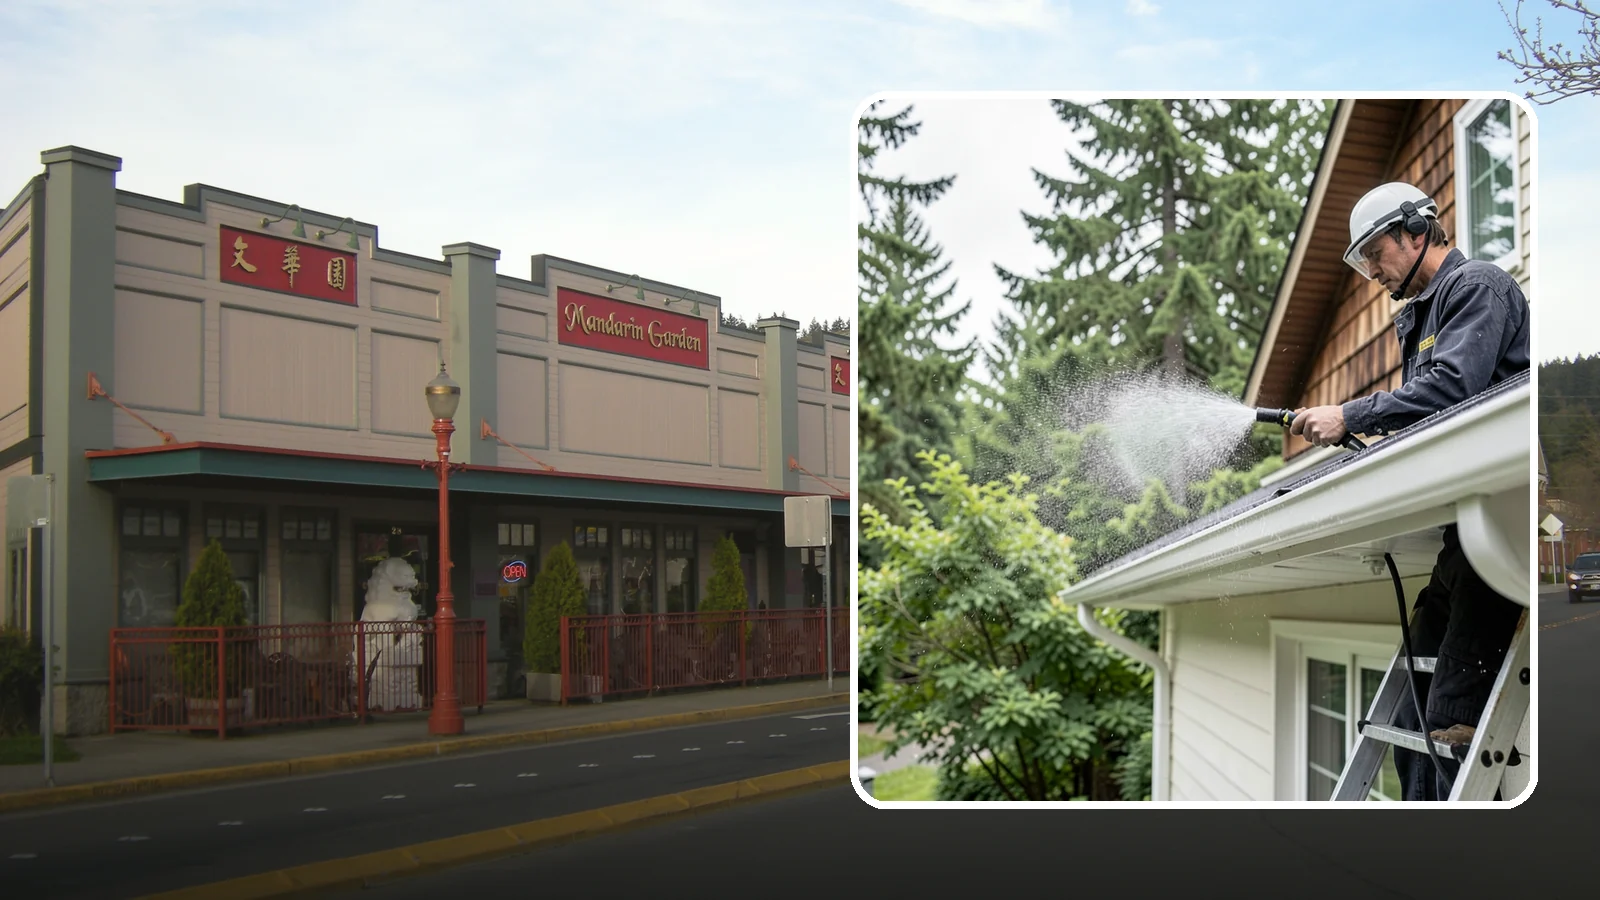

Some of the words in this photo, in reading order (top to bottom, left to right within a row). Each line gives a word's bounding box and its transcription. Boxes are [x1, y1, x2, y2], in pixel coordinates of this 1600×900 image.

[565, 302, 644, 340] Mandarin
[648, 320, 702, 352] Garden
[503, 565, 527, 578] OPEN
